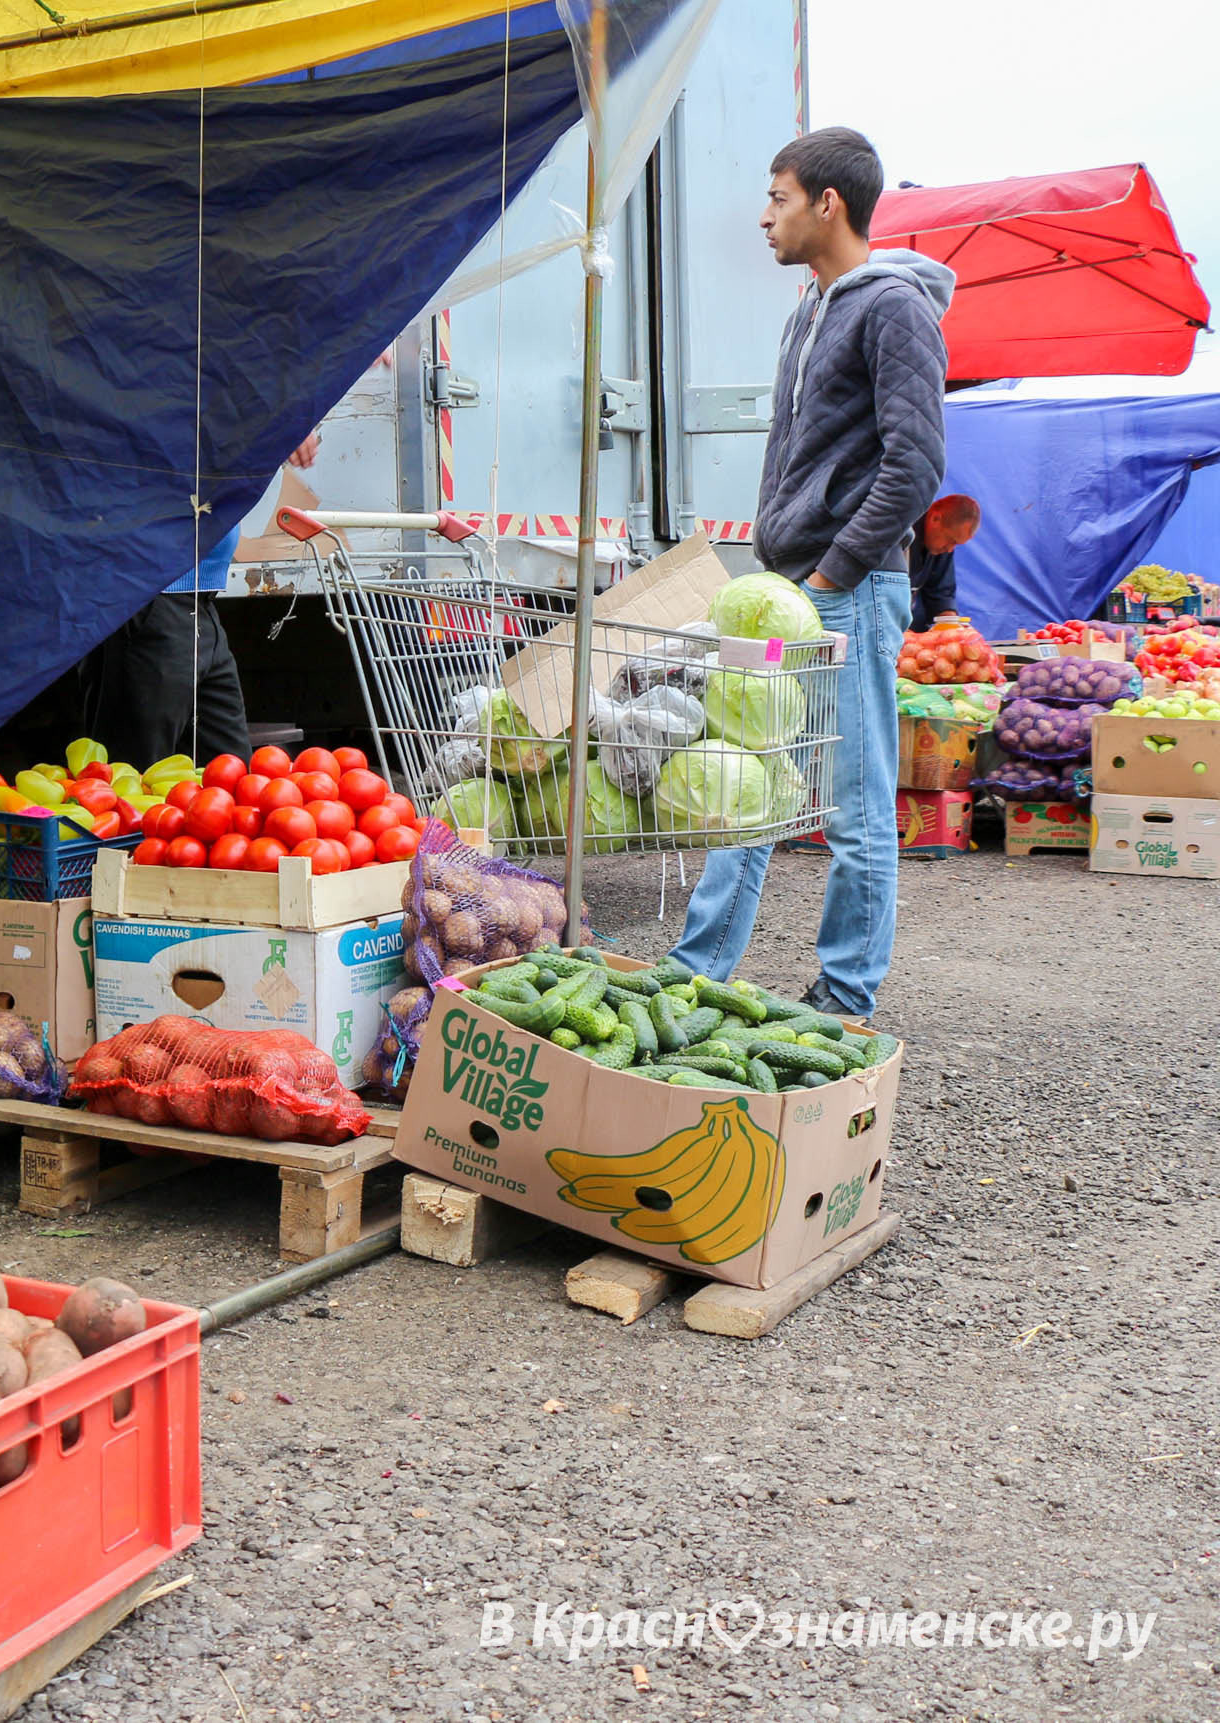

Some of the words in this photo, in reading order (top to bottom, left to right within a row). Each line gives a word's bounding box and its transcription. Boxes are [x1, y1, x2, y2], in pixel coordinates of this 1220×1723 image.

[1134, 840, 1173, 855] Global
[1138, 853, 1179, 869] Village
[96, 923, 145, 936] CAVENDISH
[147, 926, 190, 939] BANANAS
[441, 1007, 543, 1082] Global
[442, 1041, 544, 1133] Village
[424, 1125, 498, 1170] Premium
[452, 1155, 528, 1195] bananas
[827, 1168, 868, 1212] Global
[822, 1199, 861, 1239] Village
